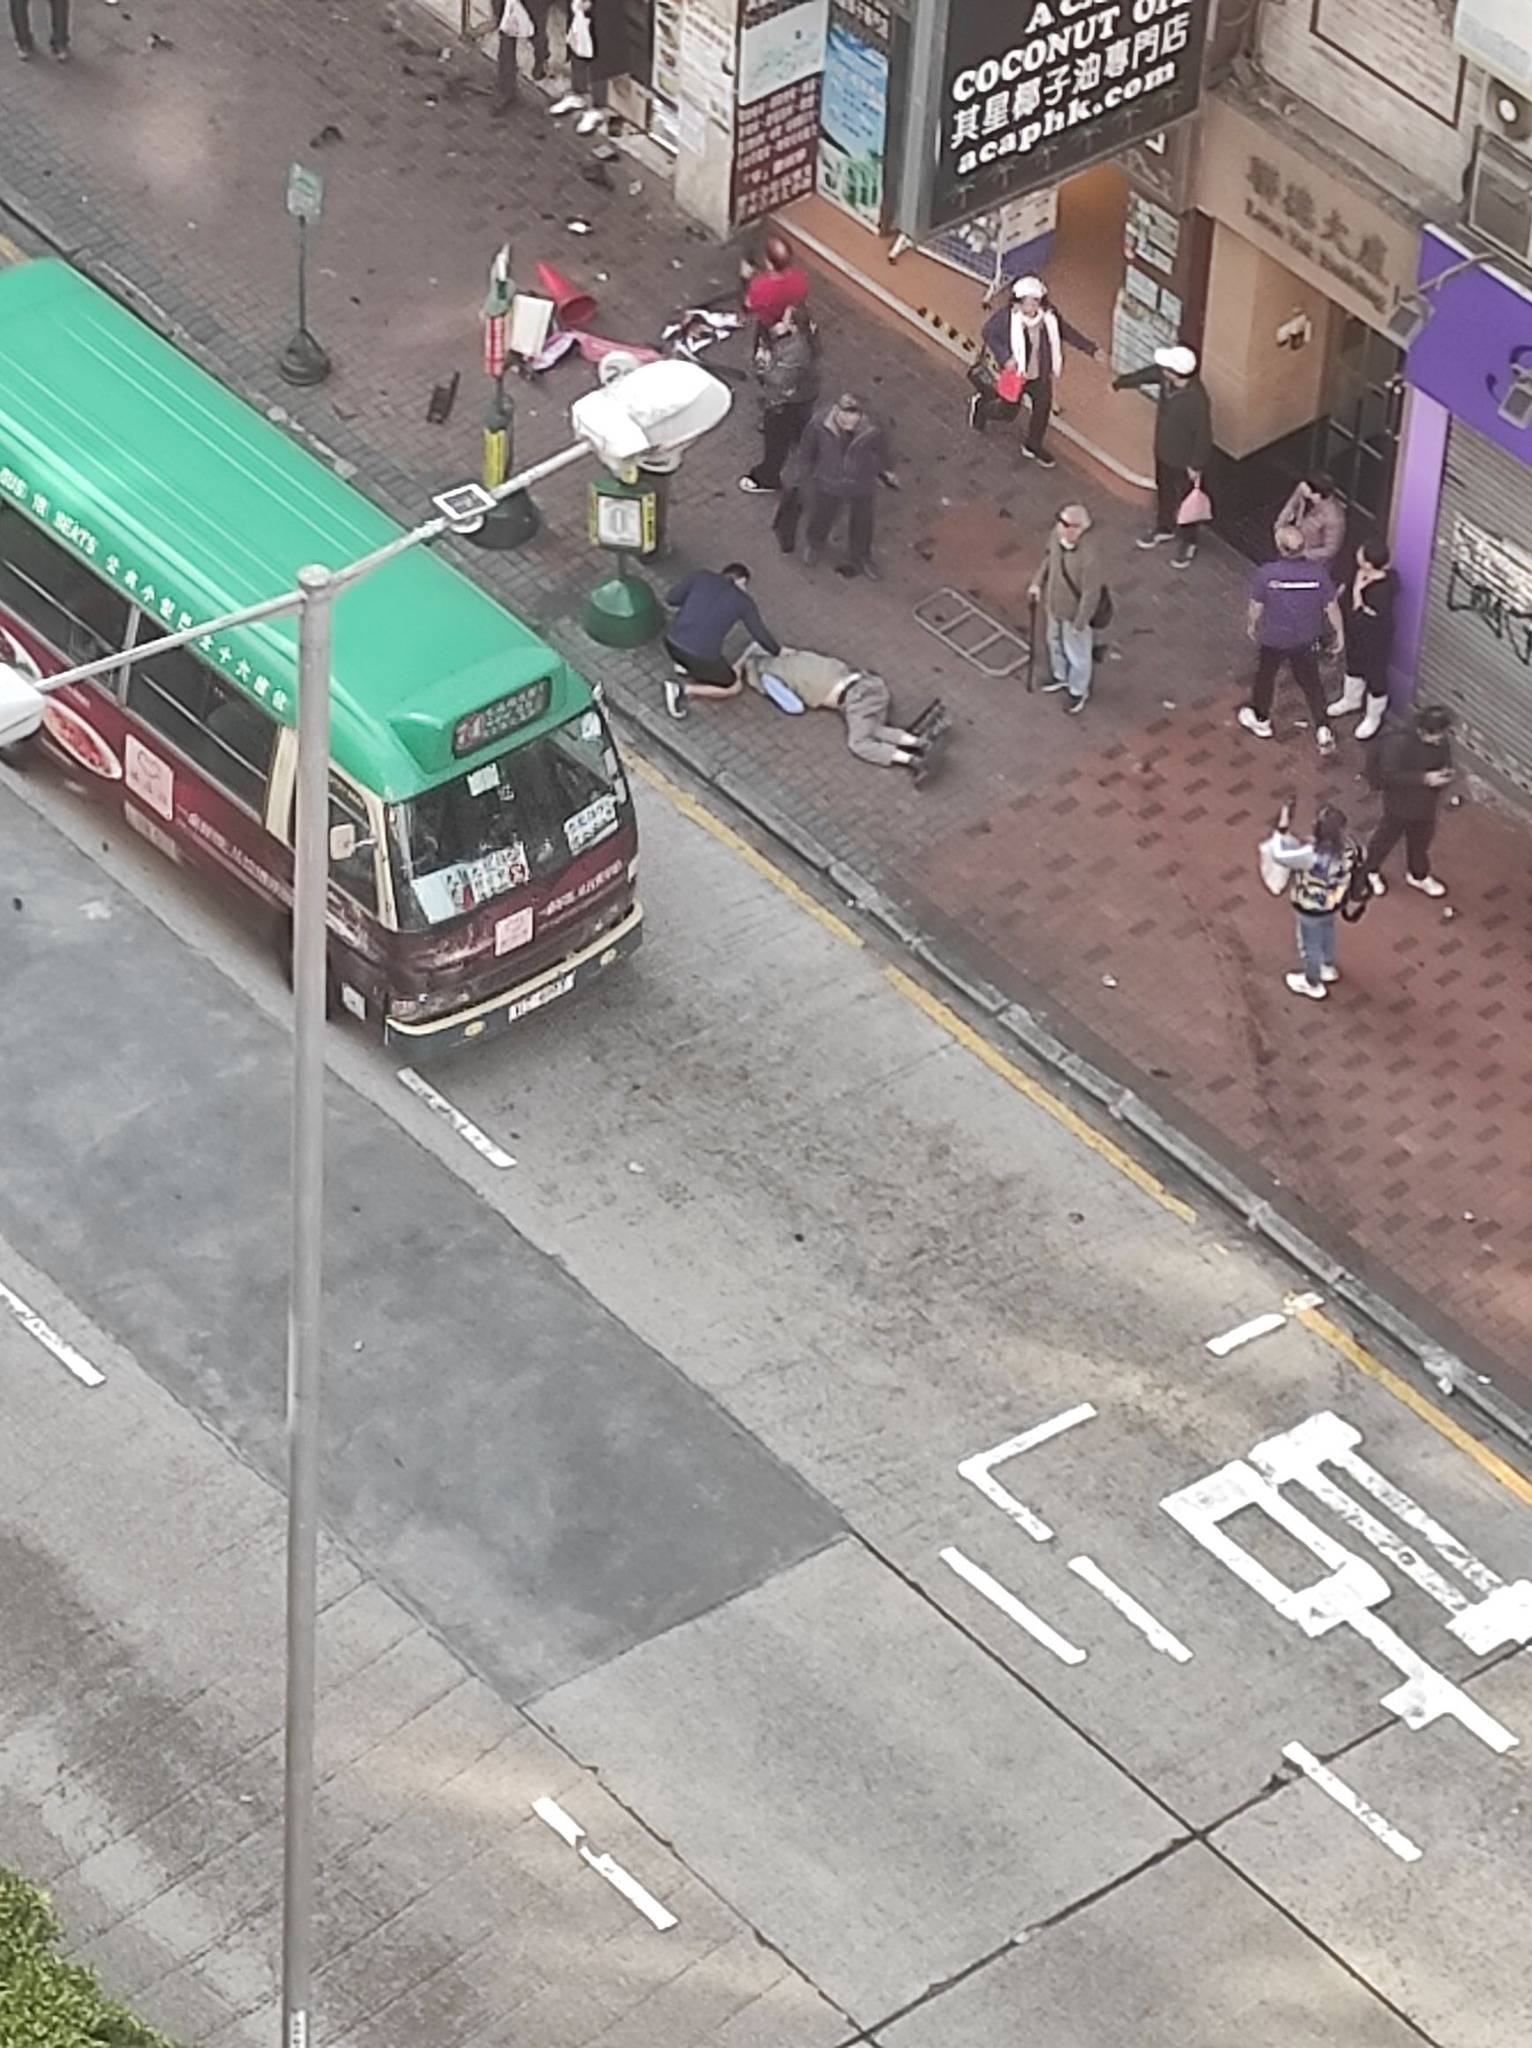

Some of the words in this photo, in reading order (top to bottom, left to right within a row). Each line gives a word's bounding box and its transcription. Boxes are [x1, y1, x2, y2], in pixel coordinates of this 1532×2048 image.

[951, 12, 1190, 149] 其星椰子油專門店
[953, 6, 1120, 101] COCONUT
[957, 61, 1175, 174] acaphk.com
